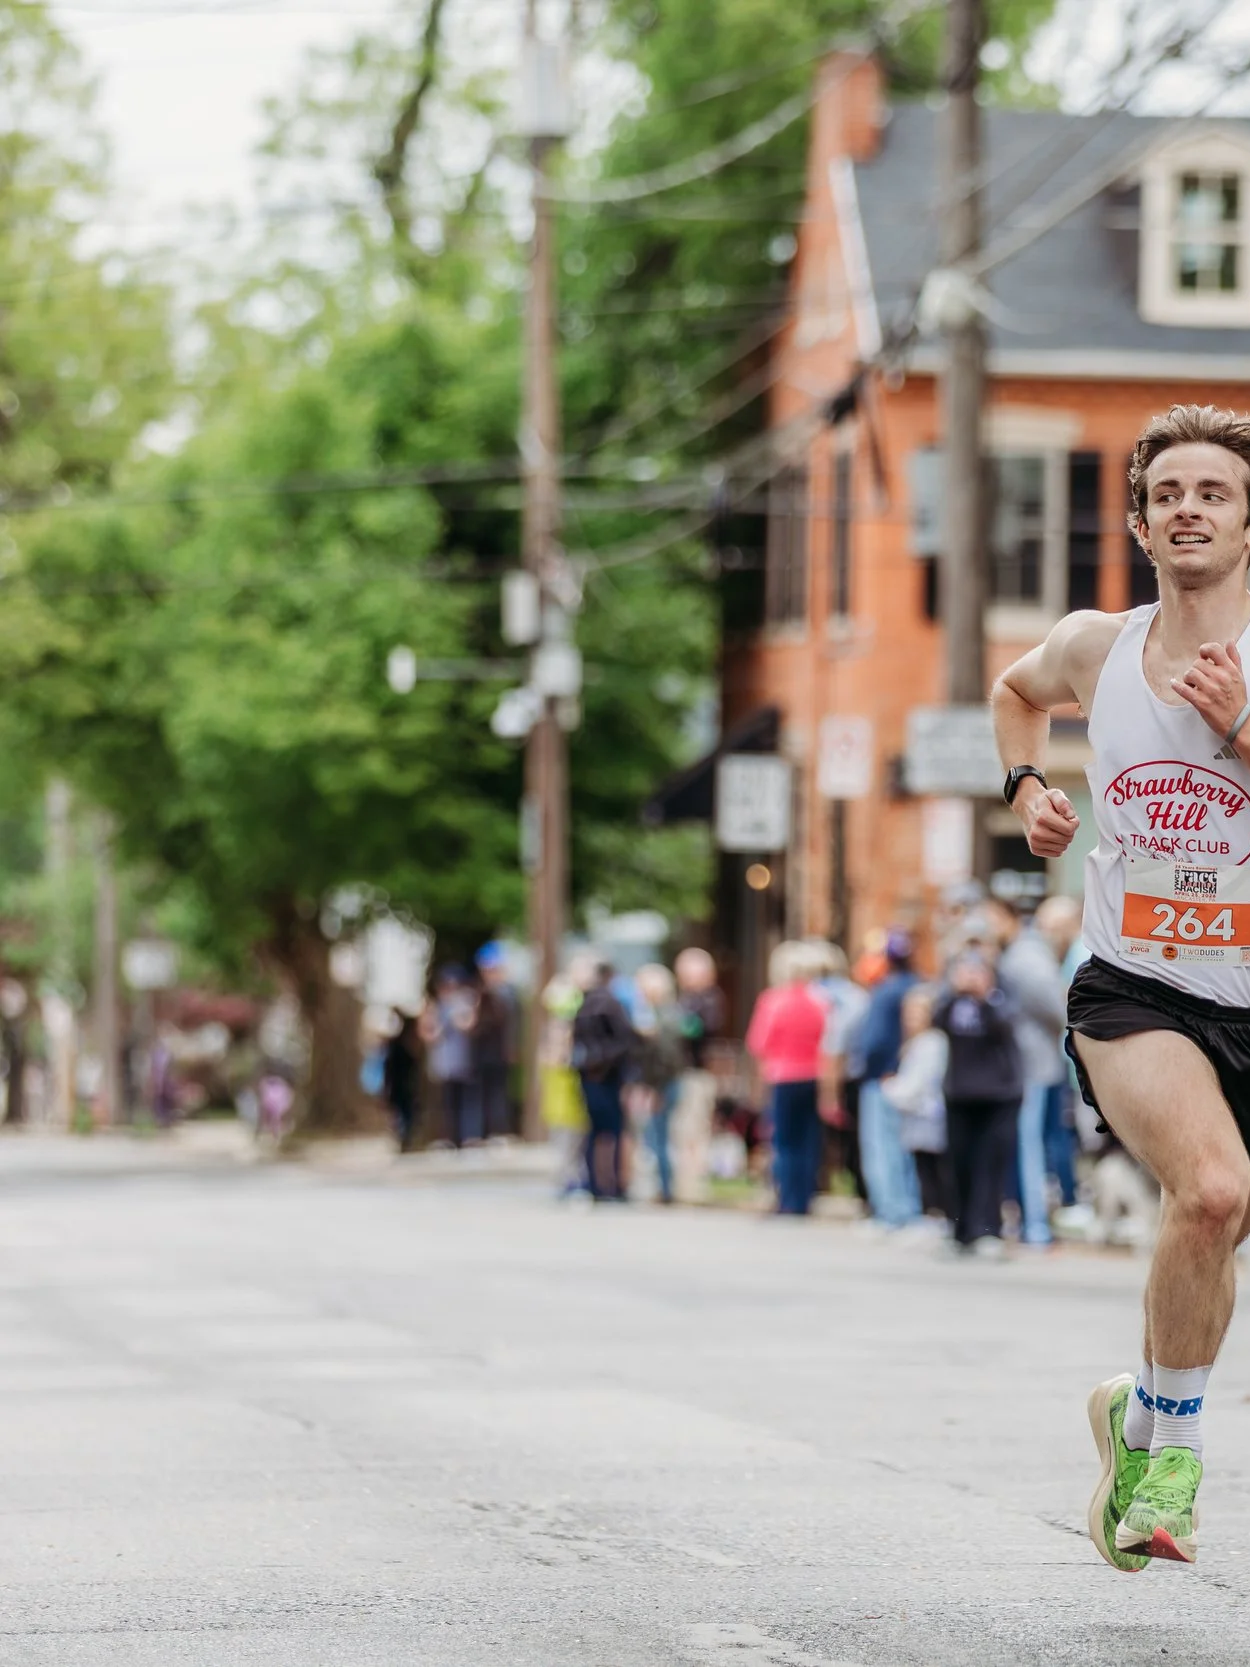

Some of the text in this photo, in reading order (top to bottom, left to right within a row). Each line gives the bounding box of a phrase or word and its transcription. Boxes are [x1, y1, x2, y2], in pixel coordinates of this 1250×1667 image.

[1112, 768, 1247, 818] Strawberry
[1146, 800, 1208, 831] Hill
[1130, 833, 1230, 855] TRACK CLUB
[1180, 870, 1217, 883] race
[1181, 883, 1217, 894] RACISM
[1149, 903, 1236, 942] 264
